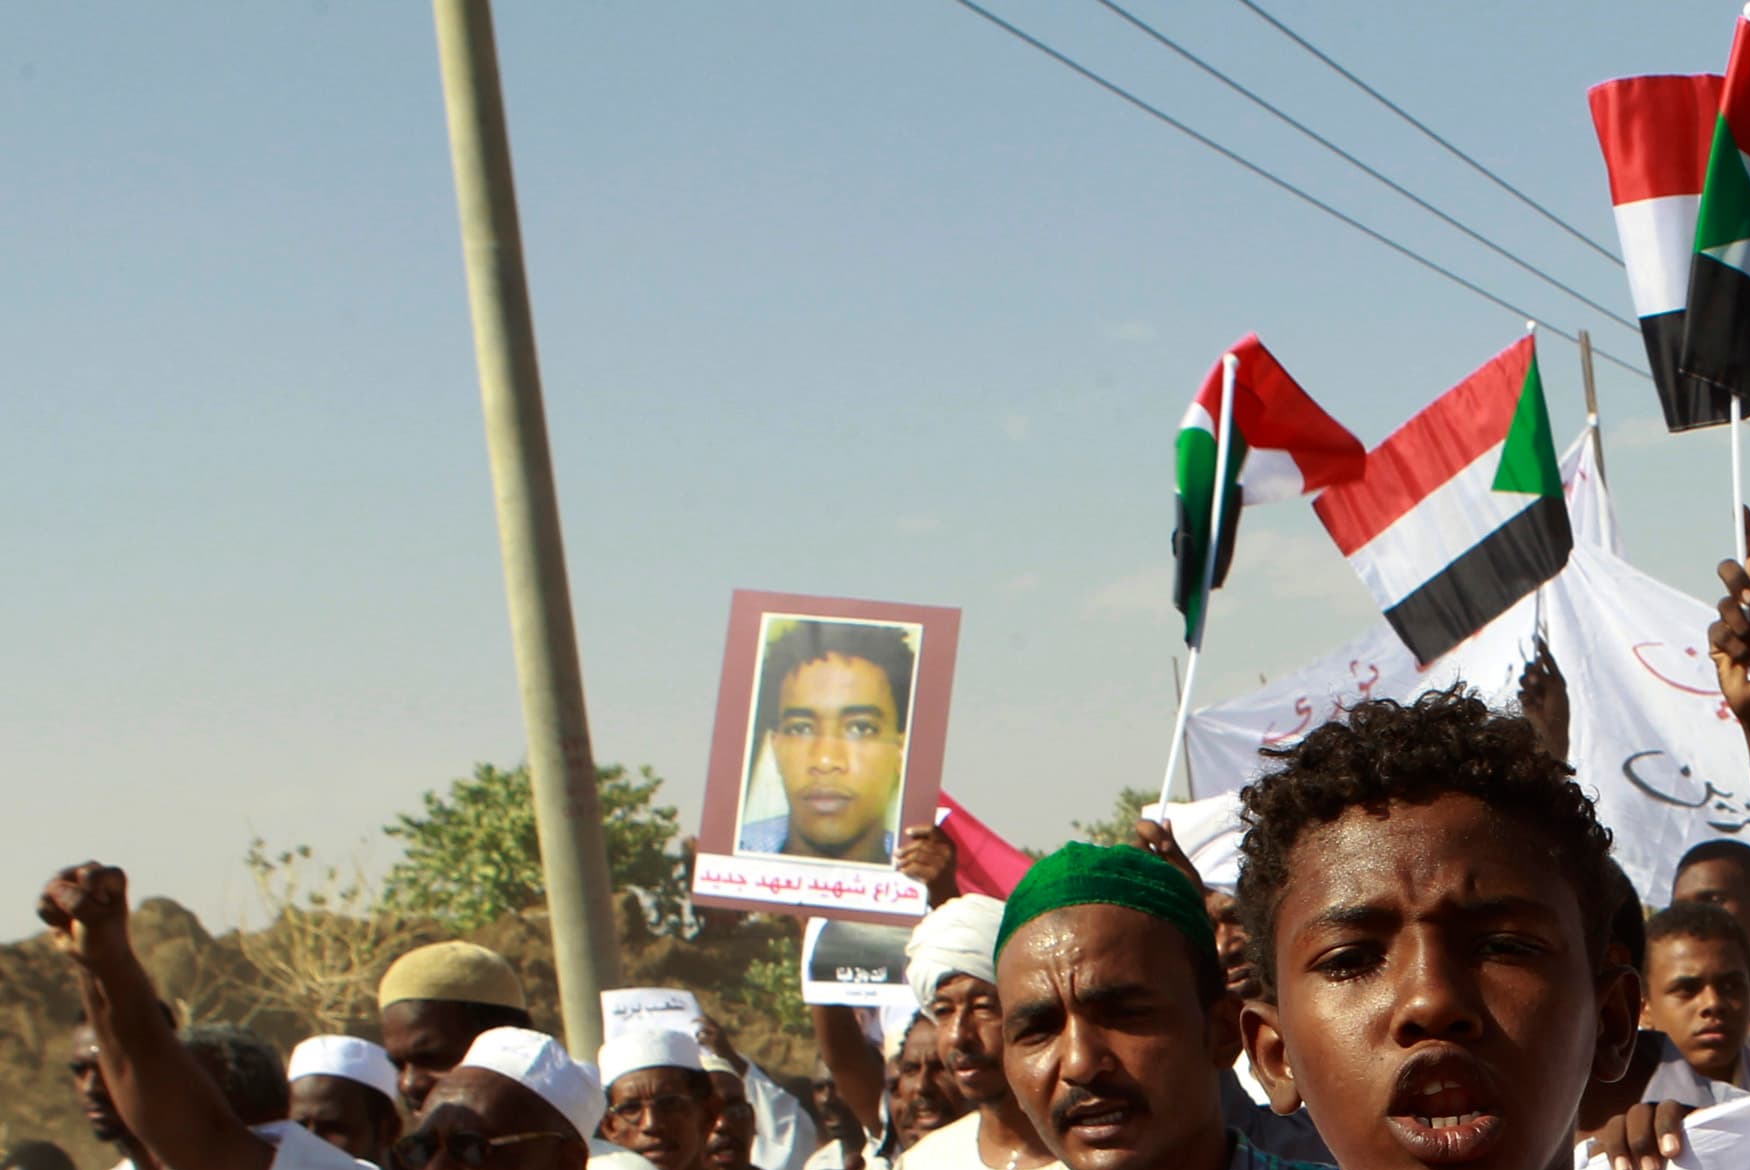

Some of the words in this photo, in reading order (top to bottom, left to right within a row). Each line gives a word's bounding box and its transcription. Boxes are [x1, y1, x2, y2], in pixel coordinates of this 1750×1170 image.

[700, 868, 748, 892] جديد
[755, 875, 803, 894] لعهد
[808, 873, 866, 898] شهيد
[873, 880, 920, 903] هزاع
